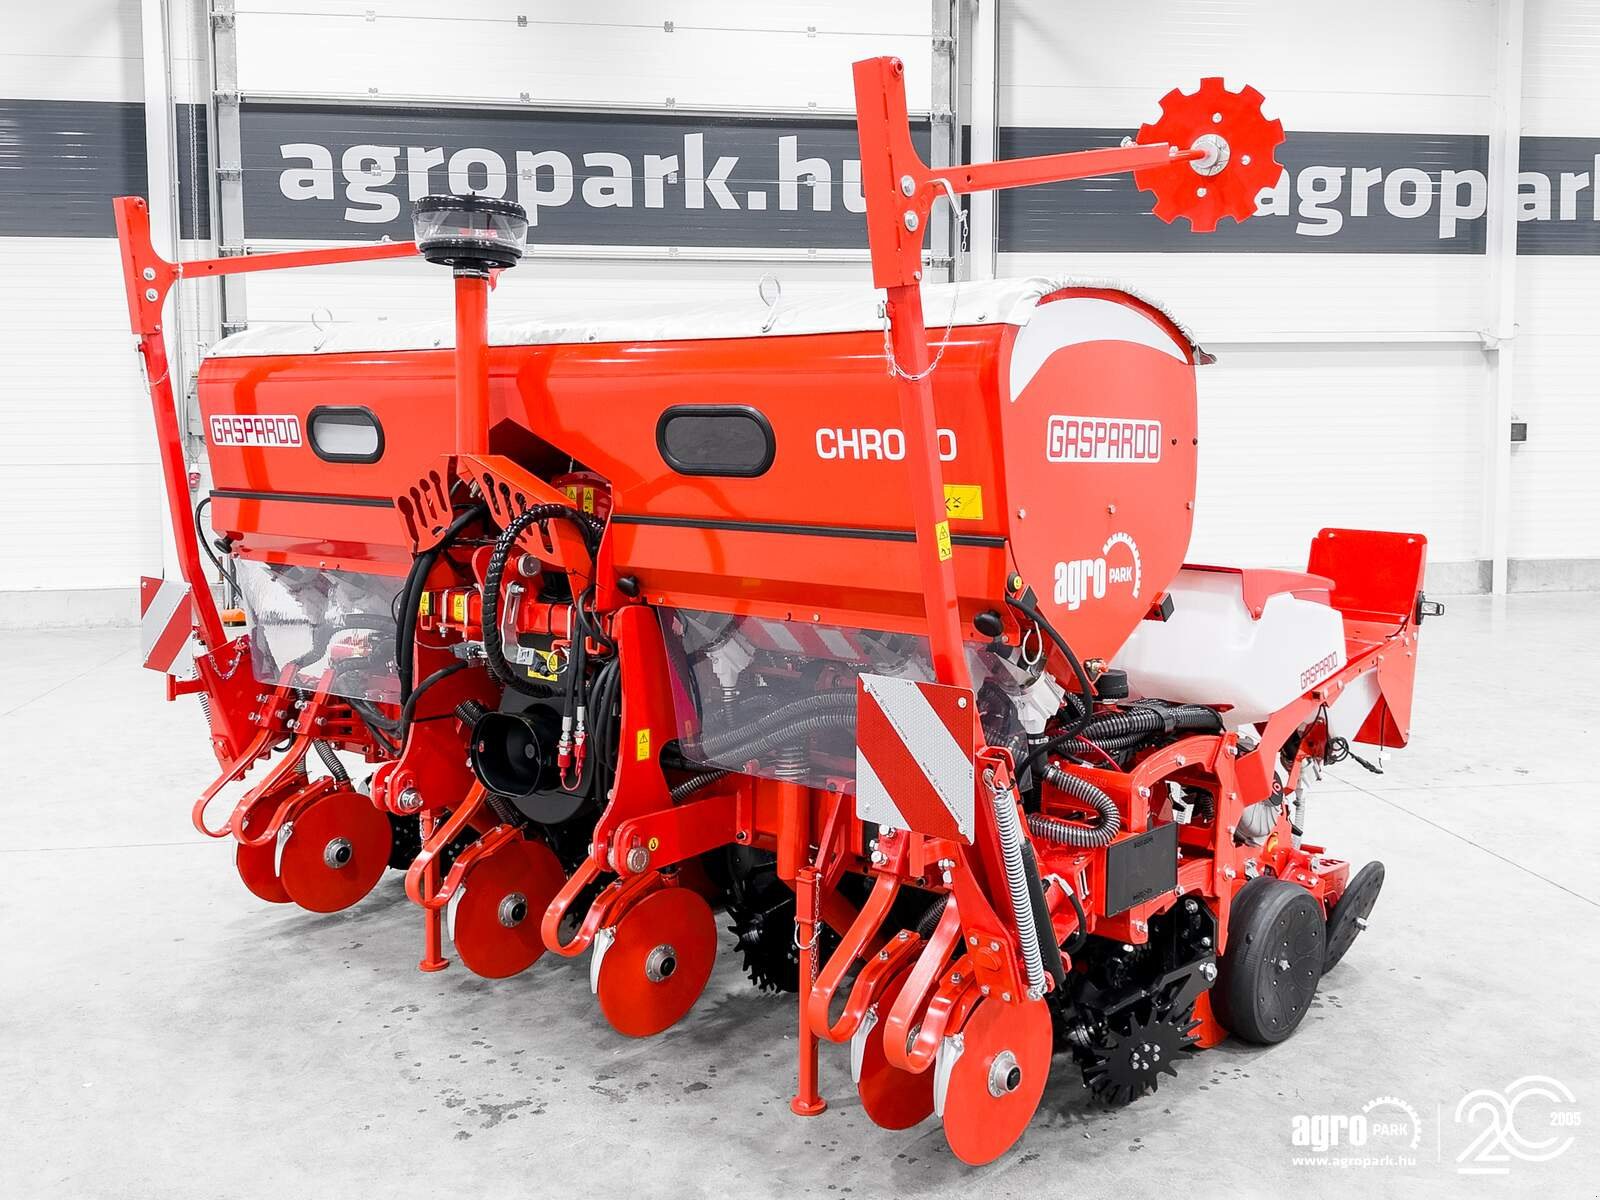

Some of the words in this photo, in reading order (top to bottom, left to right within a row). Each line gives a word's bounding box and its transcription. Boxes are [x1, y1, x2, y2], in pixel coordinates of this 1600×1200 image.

[1251, 153, 1600, 240] agropar
[211, 417, 301, 444] GASPARDO
[815, 427, 958, 462] CHROO
[1049, 419, 1160, 459] GASPARDO
[1053, 557, 1107, 612] agro
[1108, 566, 1133, 584] PARK
[1300, 650, 1338, 690] GASPARDO
